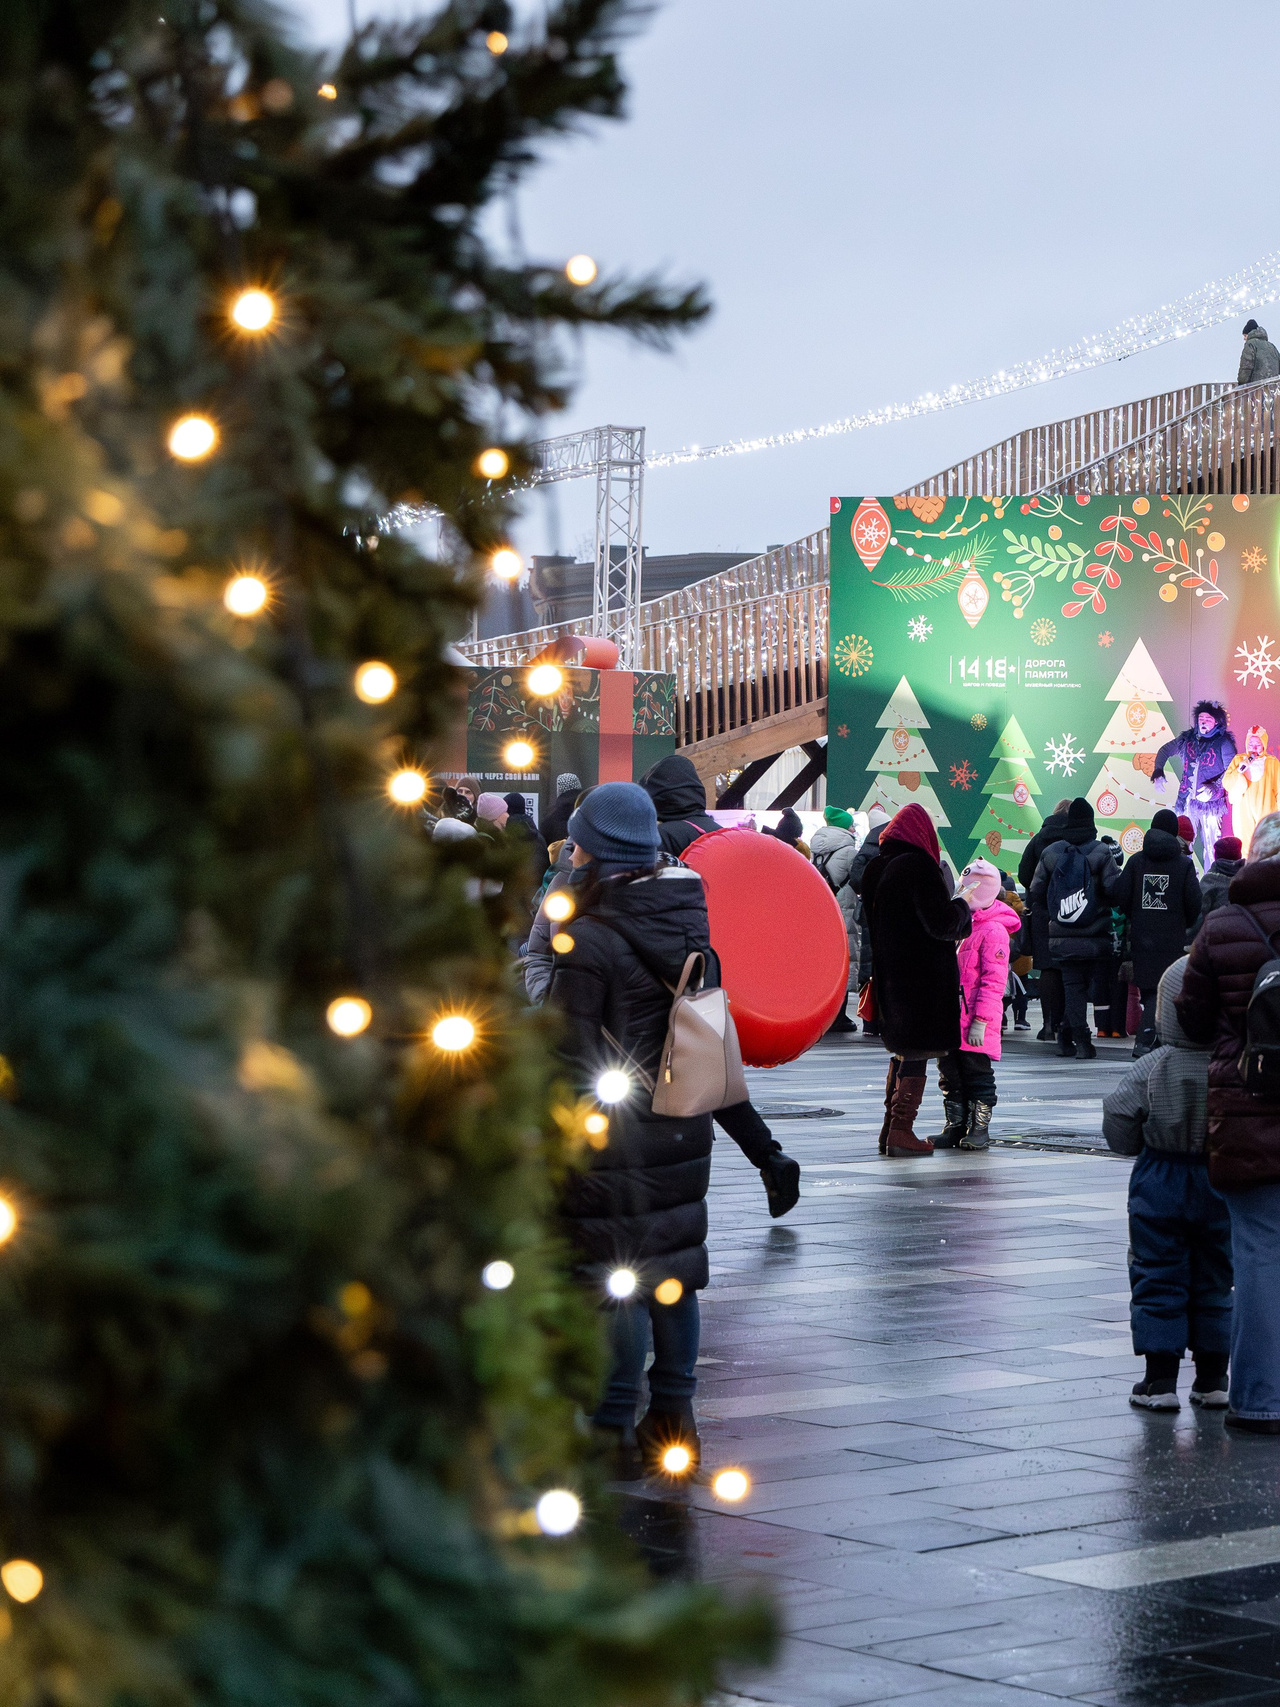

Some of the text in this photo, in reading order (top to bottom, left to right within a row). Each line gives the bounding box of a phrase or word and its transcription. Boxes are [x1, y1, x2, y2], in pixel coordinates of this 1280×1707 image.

[1024, 659, 1066, 669] ДОРОГА
[1024, 670, 1068, 679] ПАМЯТИ
[1060, 888, 1085, 917] NIKE
